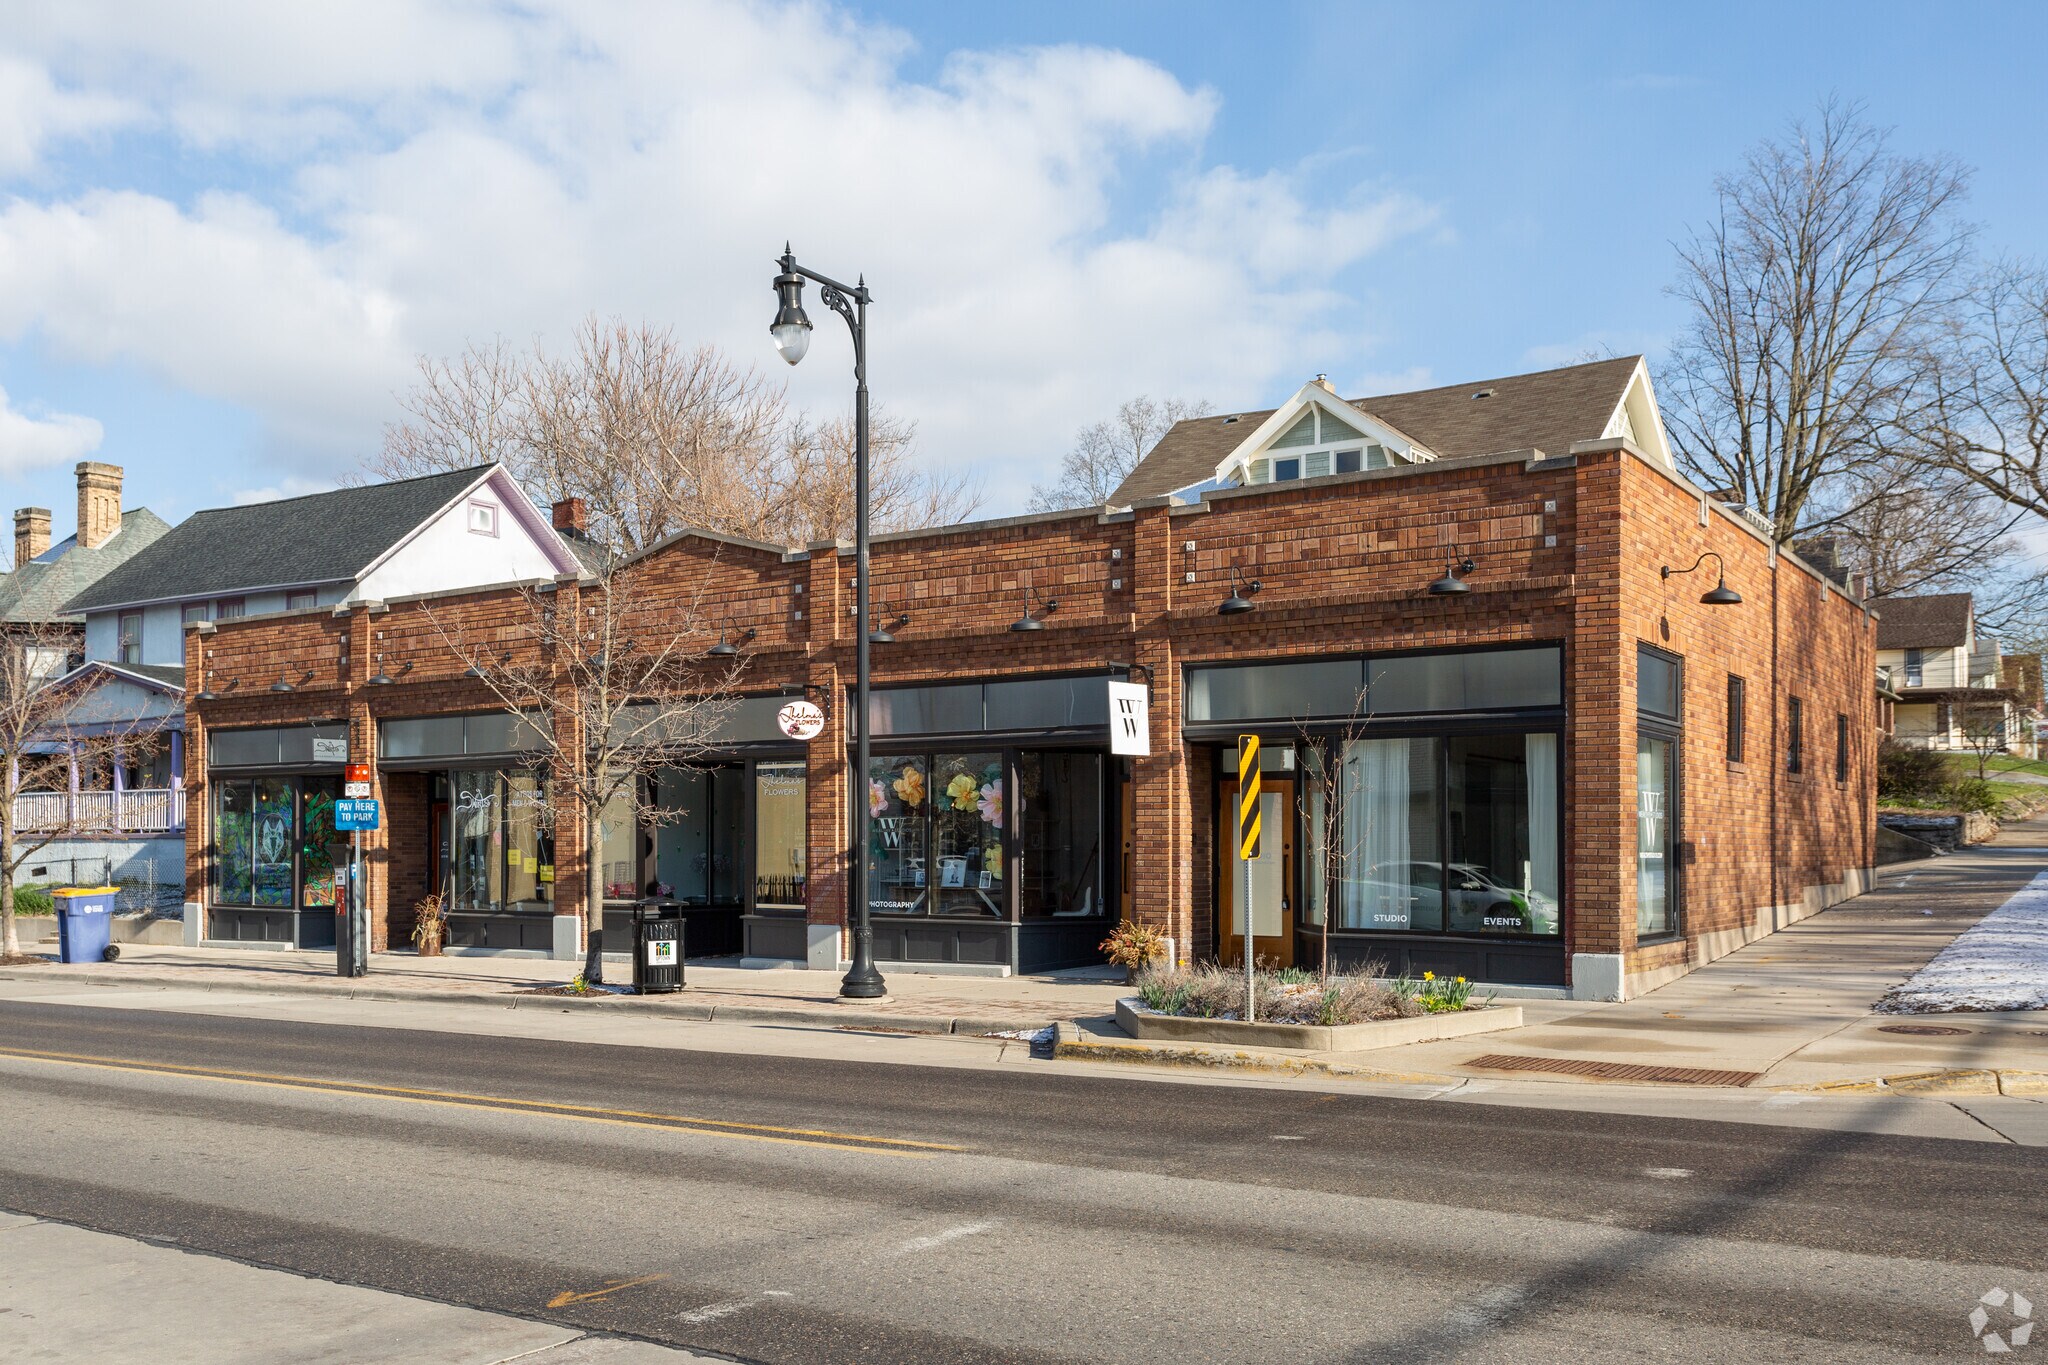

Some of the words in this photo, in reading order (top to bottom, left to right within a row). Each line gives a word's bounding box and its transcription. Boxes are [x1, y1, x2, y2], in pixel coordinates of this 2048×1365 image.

[764, 788, 799, 796] FLOWERS
[339, 802, 353, 811] PAY
[355, 802, 376, 811] HERE
[341, 812, 352, 821] TO
[353, 812, 374, 821] PARK
[1373, 914, 1408, 922] STUDIO
[1483, 917, 1522, 926] EVENTS
